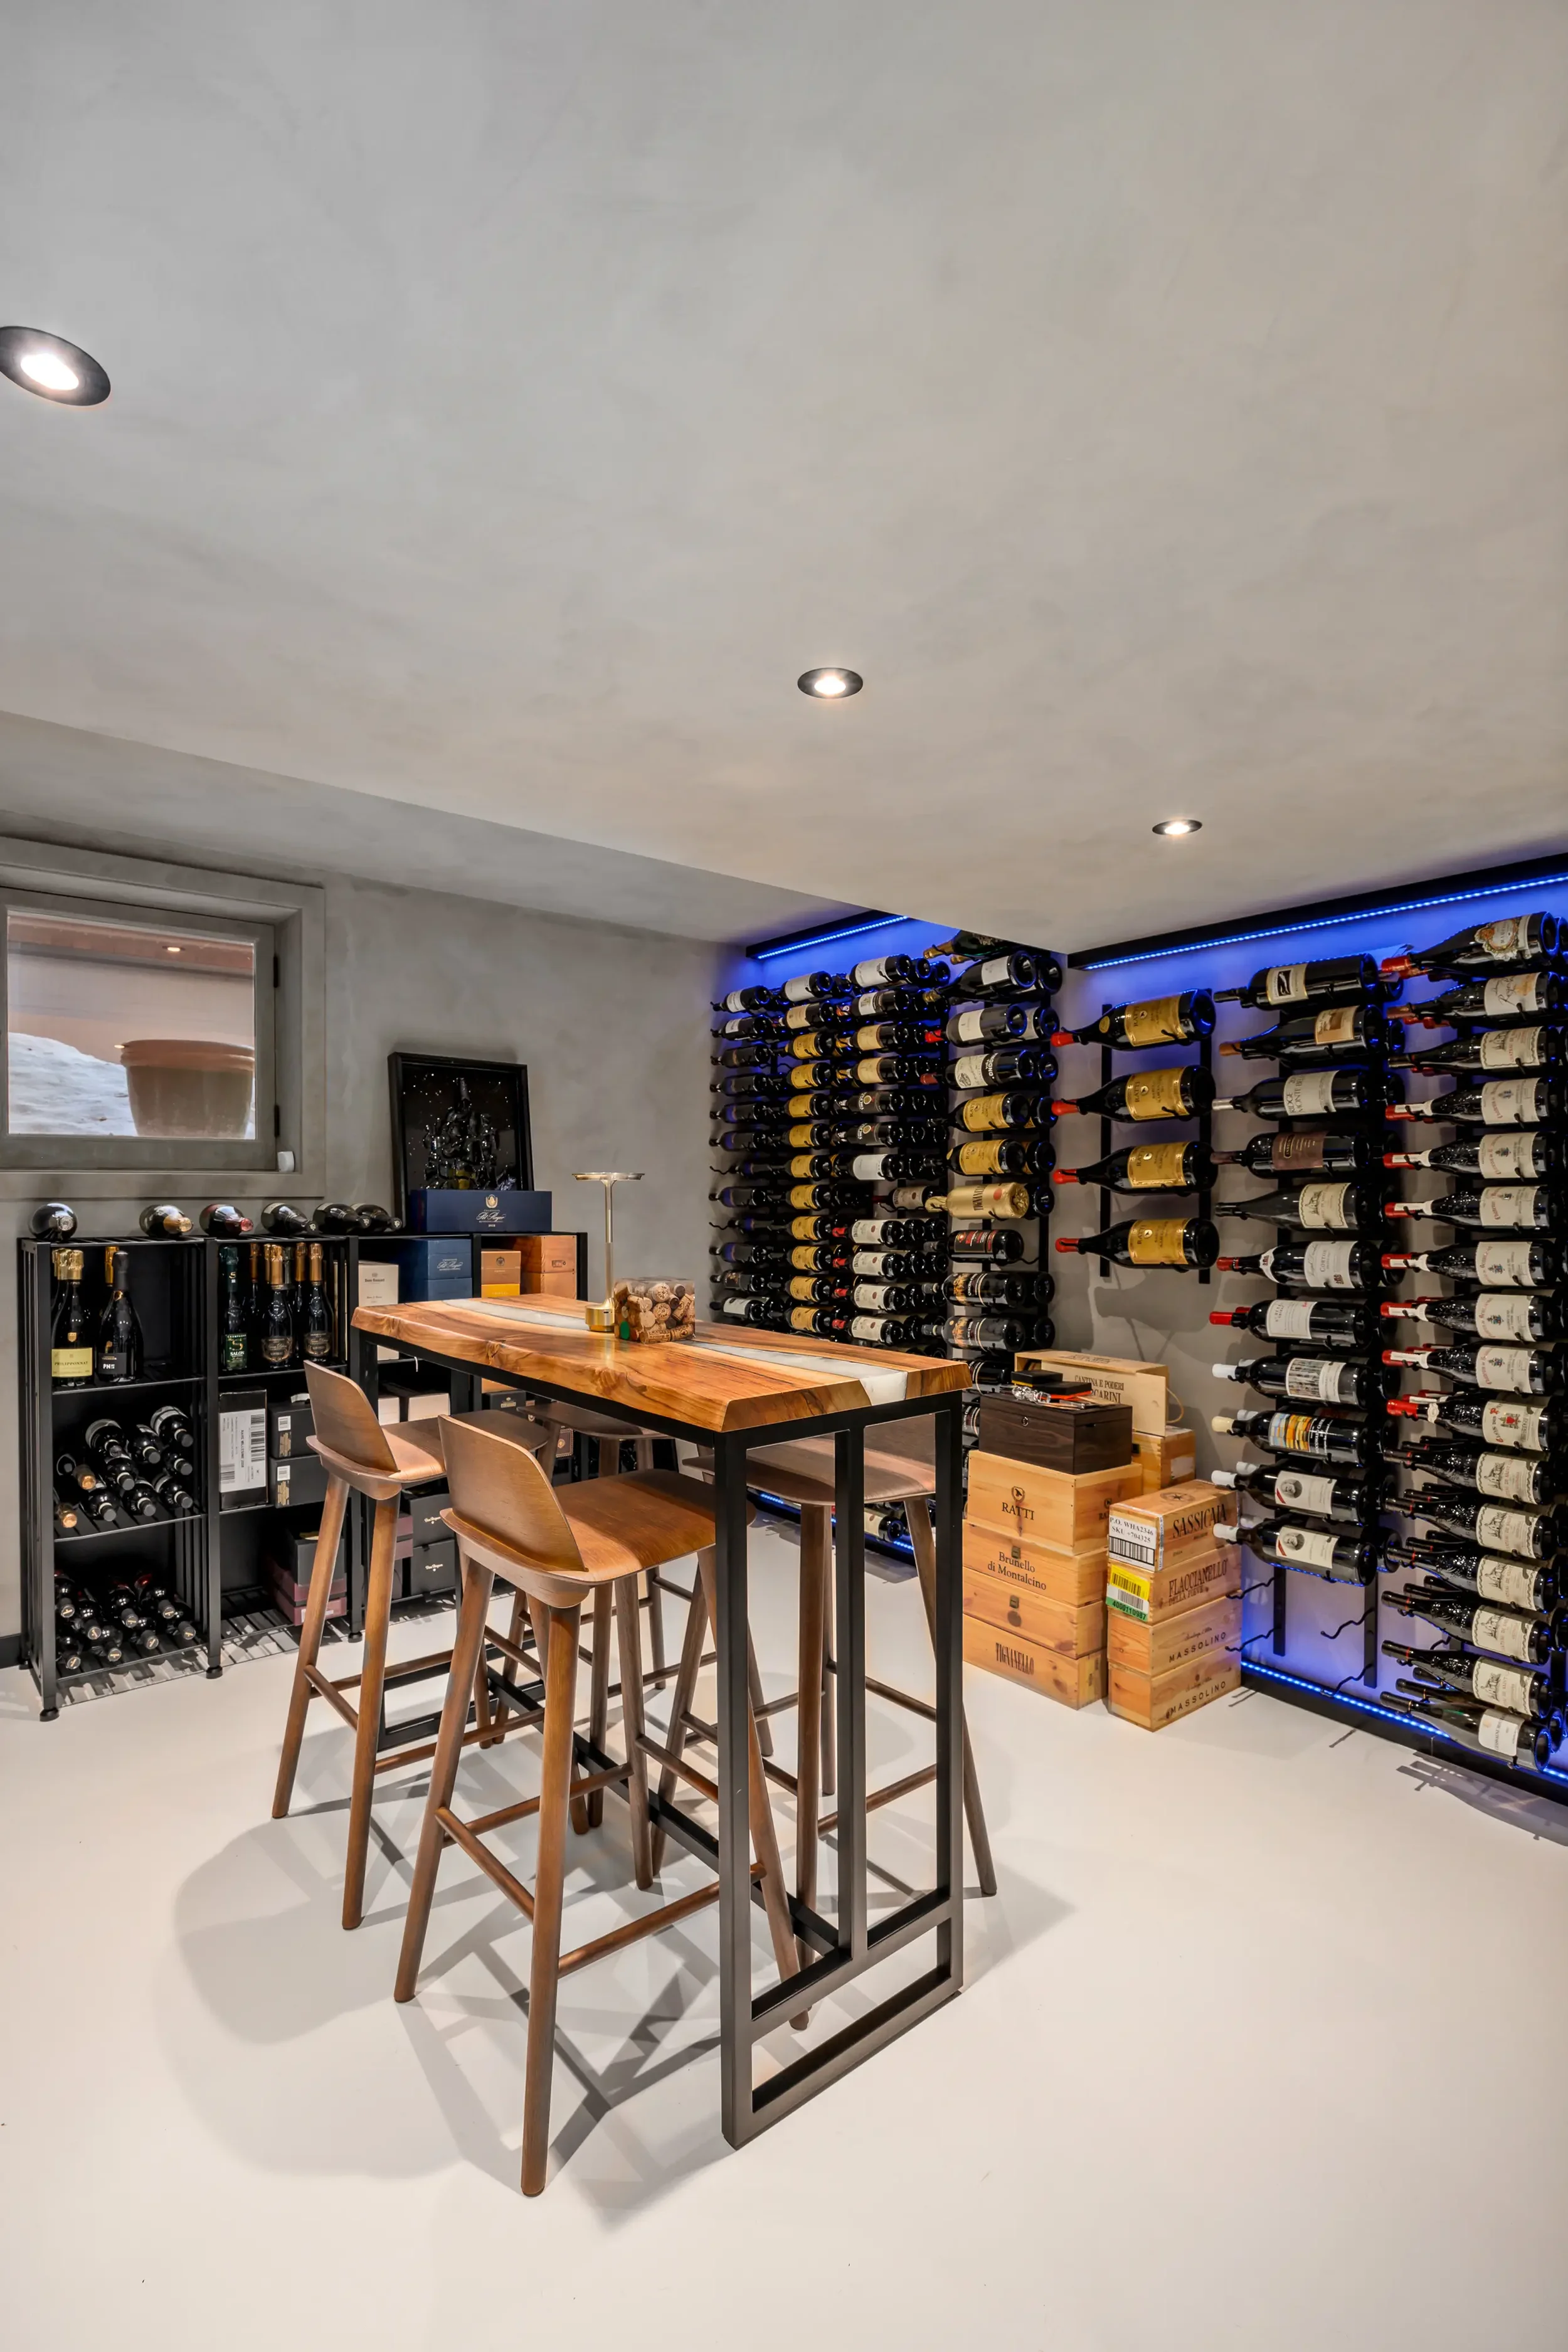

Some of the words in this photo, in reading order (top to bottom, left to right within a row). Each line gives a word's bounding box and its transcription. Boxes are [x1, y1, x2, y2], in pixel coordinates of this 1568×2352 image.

[1286, 1092, 1296, 1113] RIDGE
[1075, 1375, 1098, 1387] CANTINA
[1104, 1380, 1124, 1391] PODERI
[1002, 1502, 1034, 1520] RATTI
[1172, 1503, 1227, 1539] SASSICAIA
[1110, 1517, 1122, 1525] P.O.
[1124, 1521, 1154, 1536] WHA2346
[1111, 1526, 1125, 1535] SKU
[987, 1560, 995, 1571] di
[998, 1564, 1047, 1591] Montalcino
[999, 1552, 1036, 1573] Brunello
[1168, 1559, 1227, 1597] FLACCIANELLO
[995, 1642, 1035, 1676] TIGNANELLO
[1169, 1632, 1226, 1663] MASSOLINO
[1170, 1681, 1226, 1716] MASSOLINO
